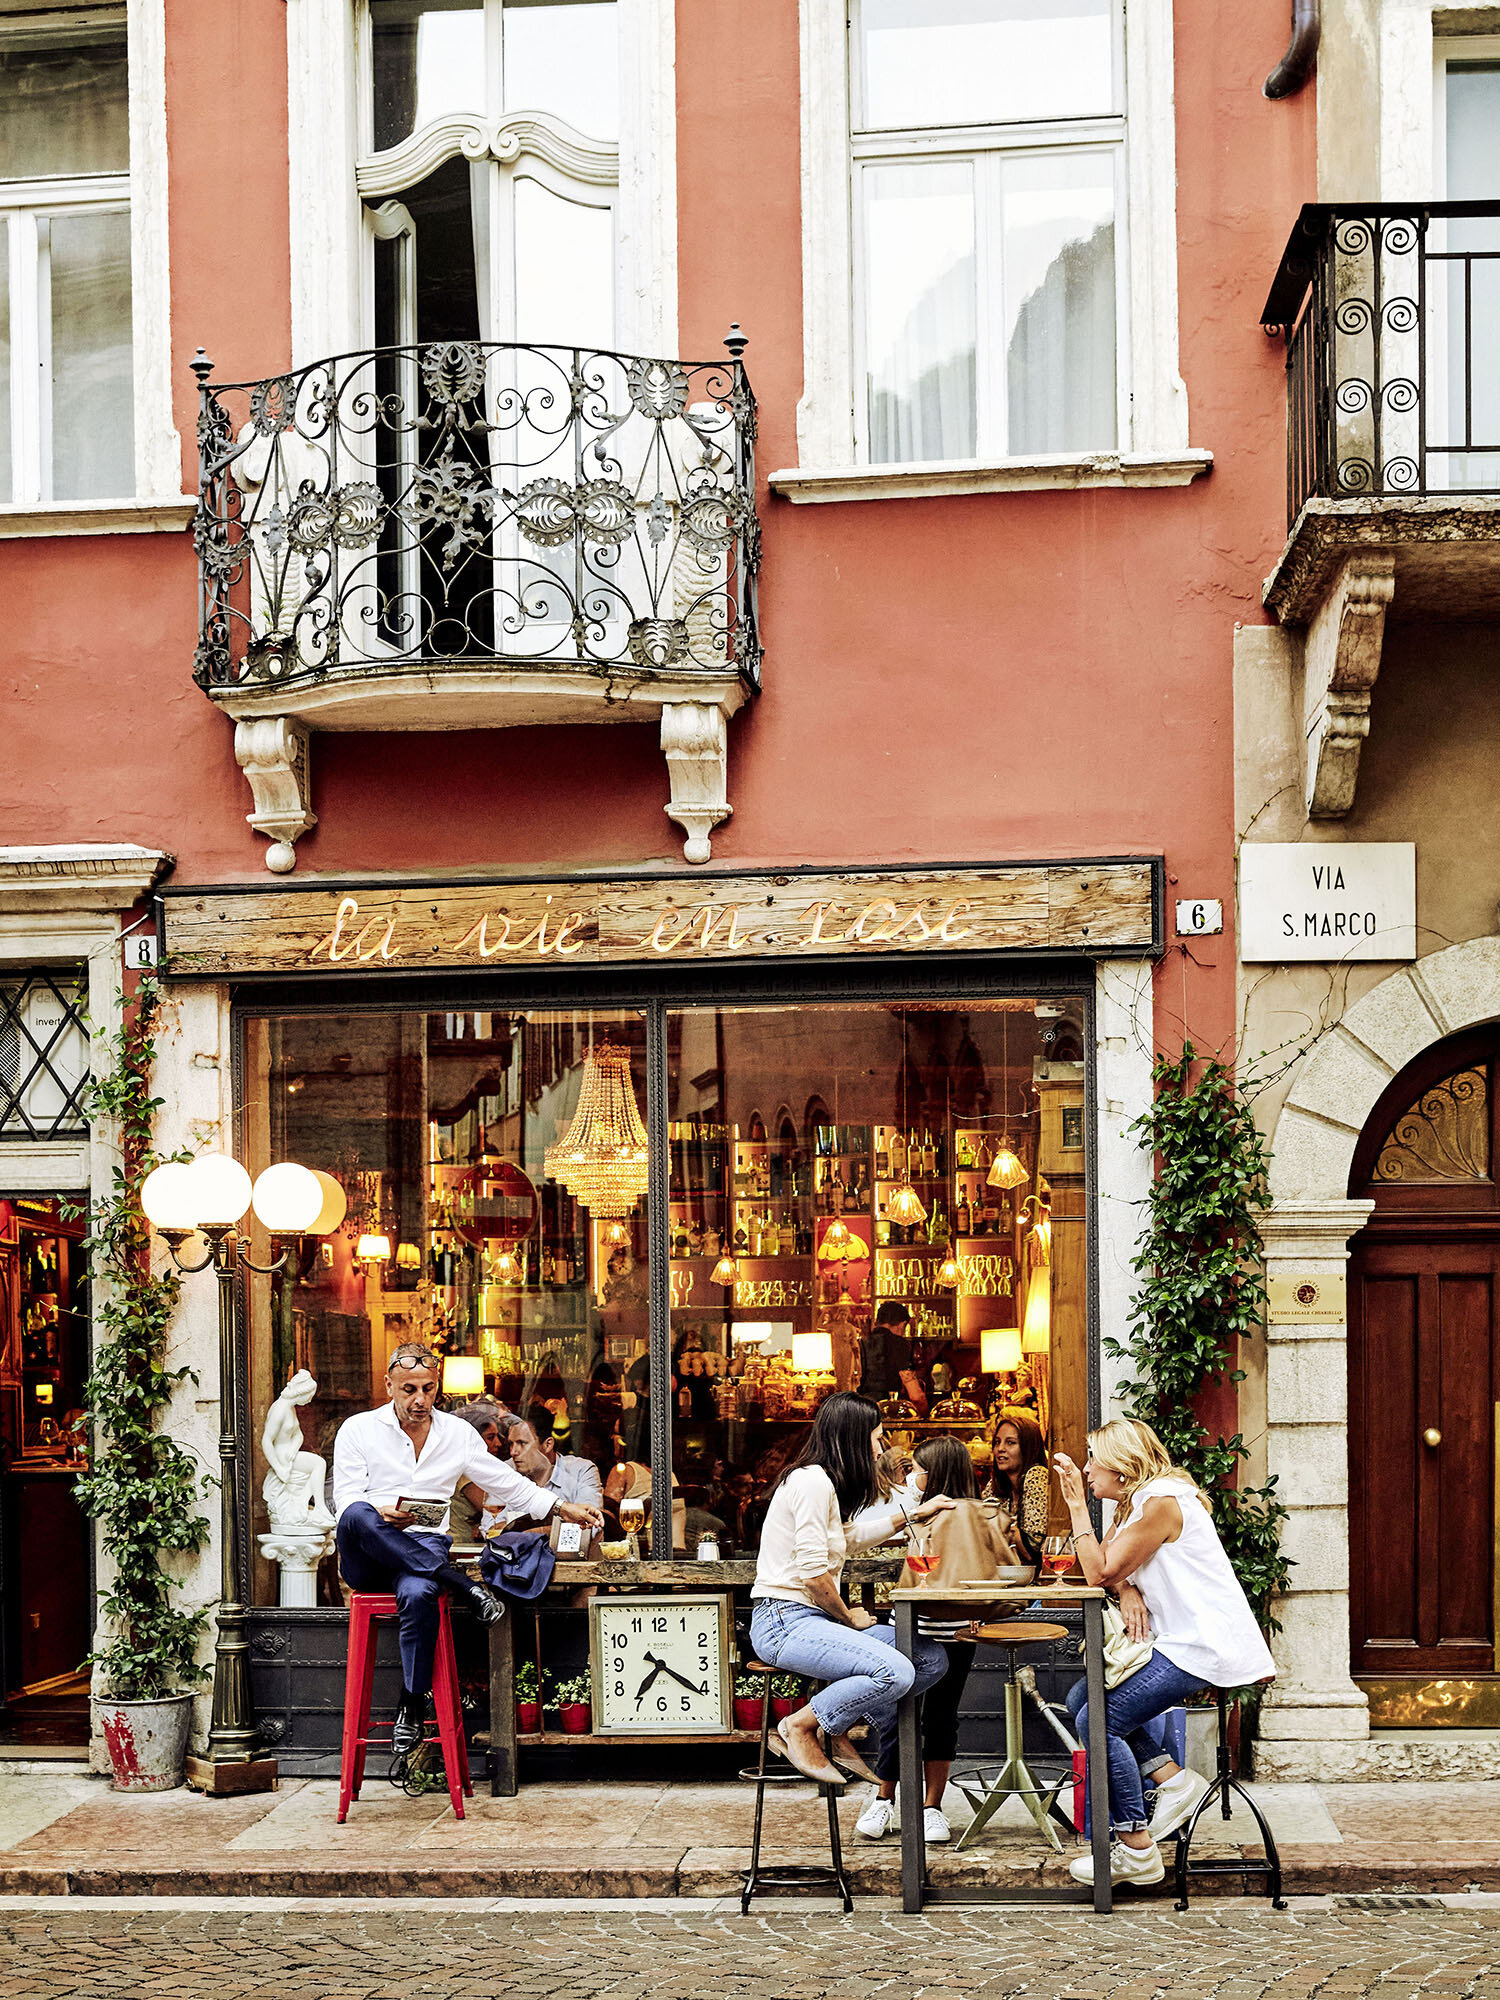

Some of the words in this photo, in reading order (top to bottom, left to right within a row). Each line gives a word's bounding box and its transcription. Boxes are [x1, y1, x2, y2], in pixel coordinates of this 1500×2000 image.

[1312, 866, 1346, 890] VIA
[1191, 903, 1205, 929] 6
[310, 897, 402, 962] la
[453, 894, 585, 957] vie
[638, 904, 750, 953] en
[798, 896, 972, 947] rose
[138, 939, 151, 963] 8
[35, 1017, 72, 1026] invert
[631, 1617, 642, 1633] 11
[651, 1617, 668, 1633] 12
[679, 1617, 686, 1633] 1
[610, 1633, 628, 1649] 10
[697, 1632, 708, 1648] 2
[613, 1657, 625, 1673] 9
[698, 1656, 709, 1672] 3
[614, 1680, 625, 1697] 8
[699, 1680, 710, 1696] 4
[634, 1697, 644, 1712] 7
[656, 1696, 668, 1712] 6
[680, 1696, 691, 1711] 5
